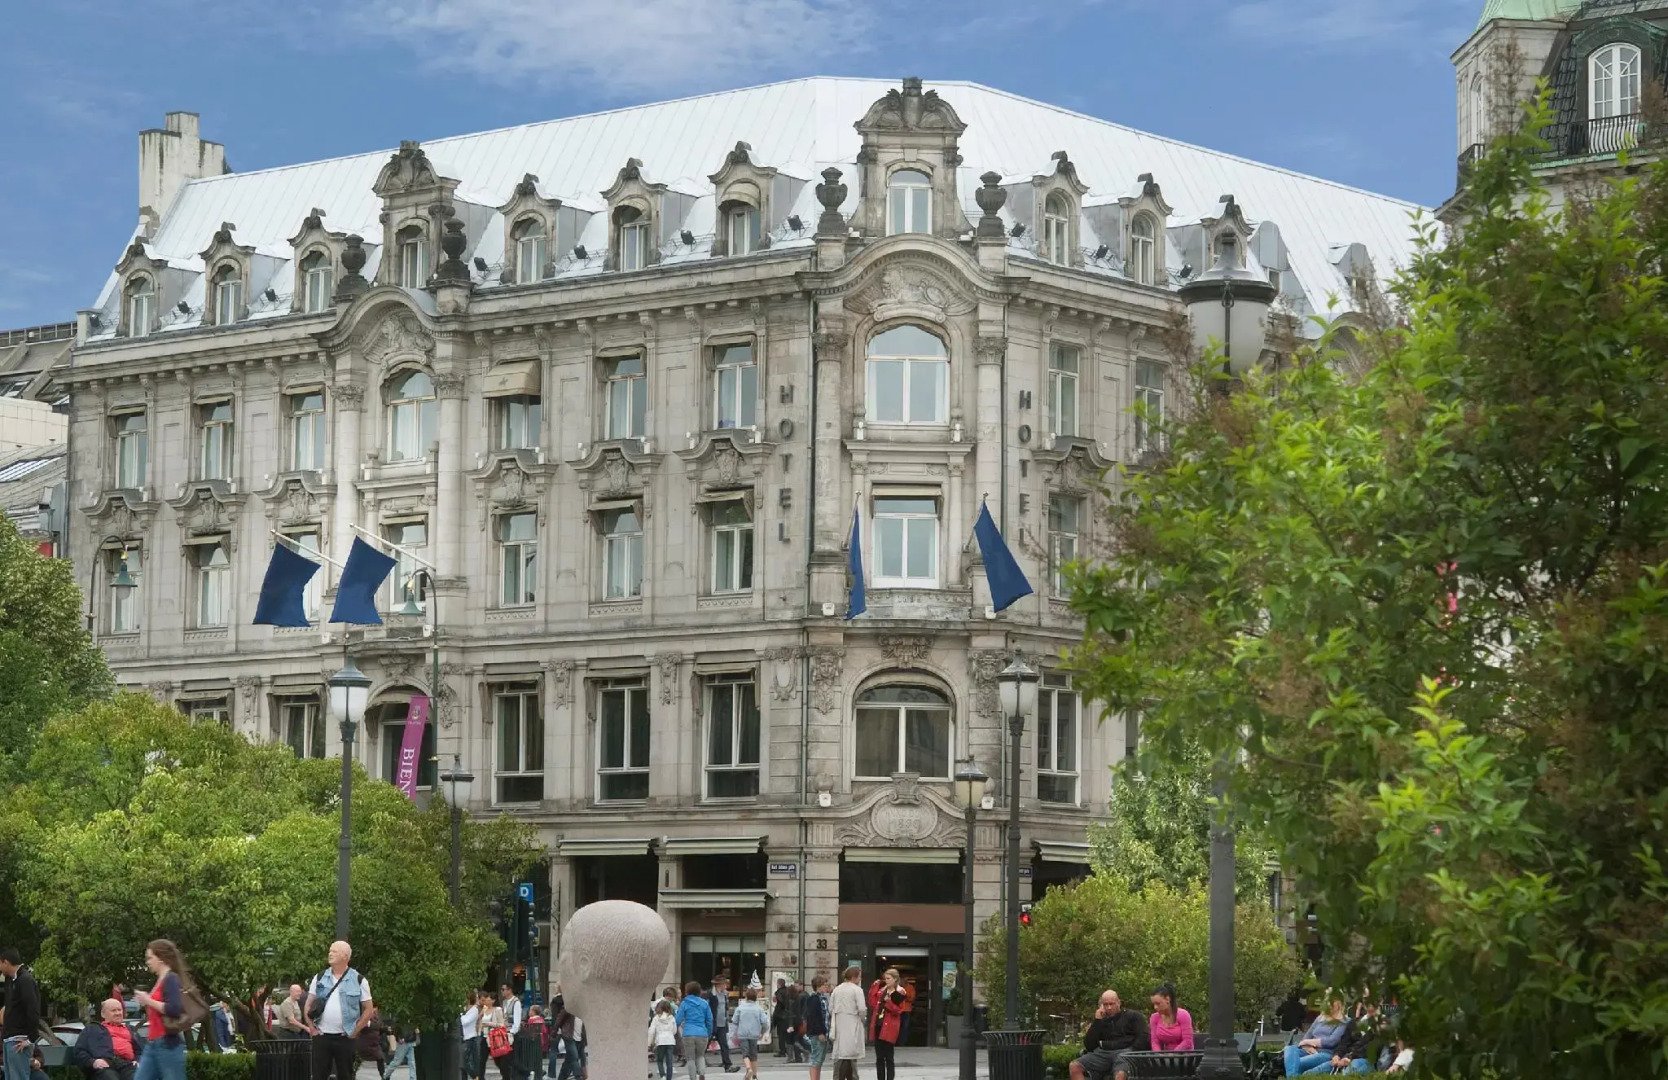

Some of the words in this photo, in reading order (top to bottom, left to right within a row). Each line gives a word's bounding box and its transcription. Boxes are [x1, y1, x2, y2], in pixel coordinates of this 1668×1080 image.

[779, 385, 794, 544] HOTEL
[1018, 390, 1032, 548] HOTEL
[400, 748, 415, 798] BIEN
[816, 938, 828, 950] 33
